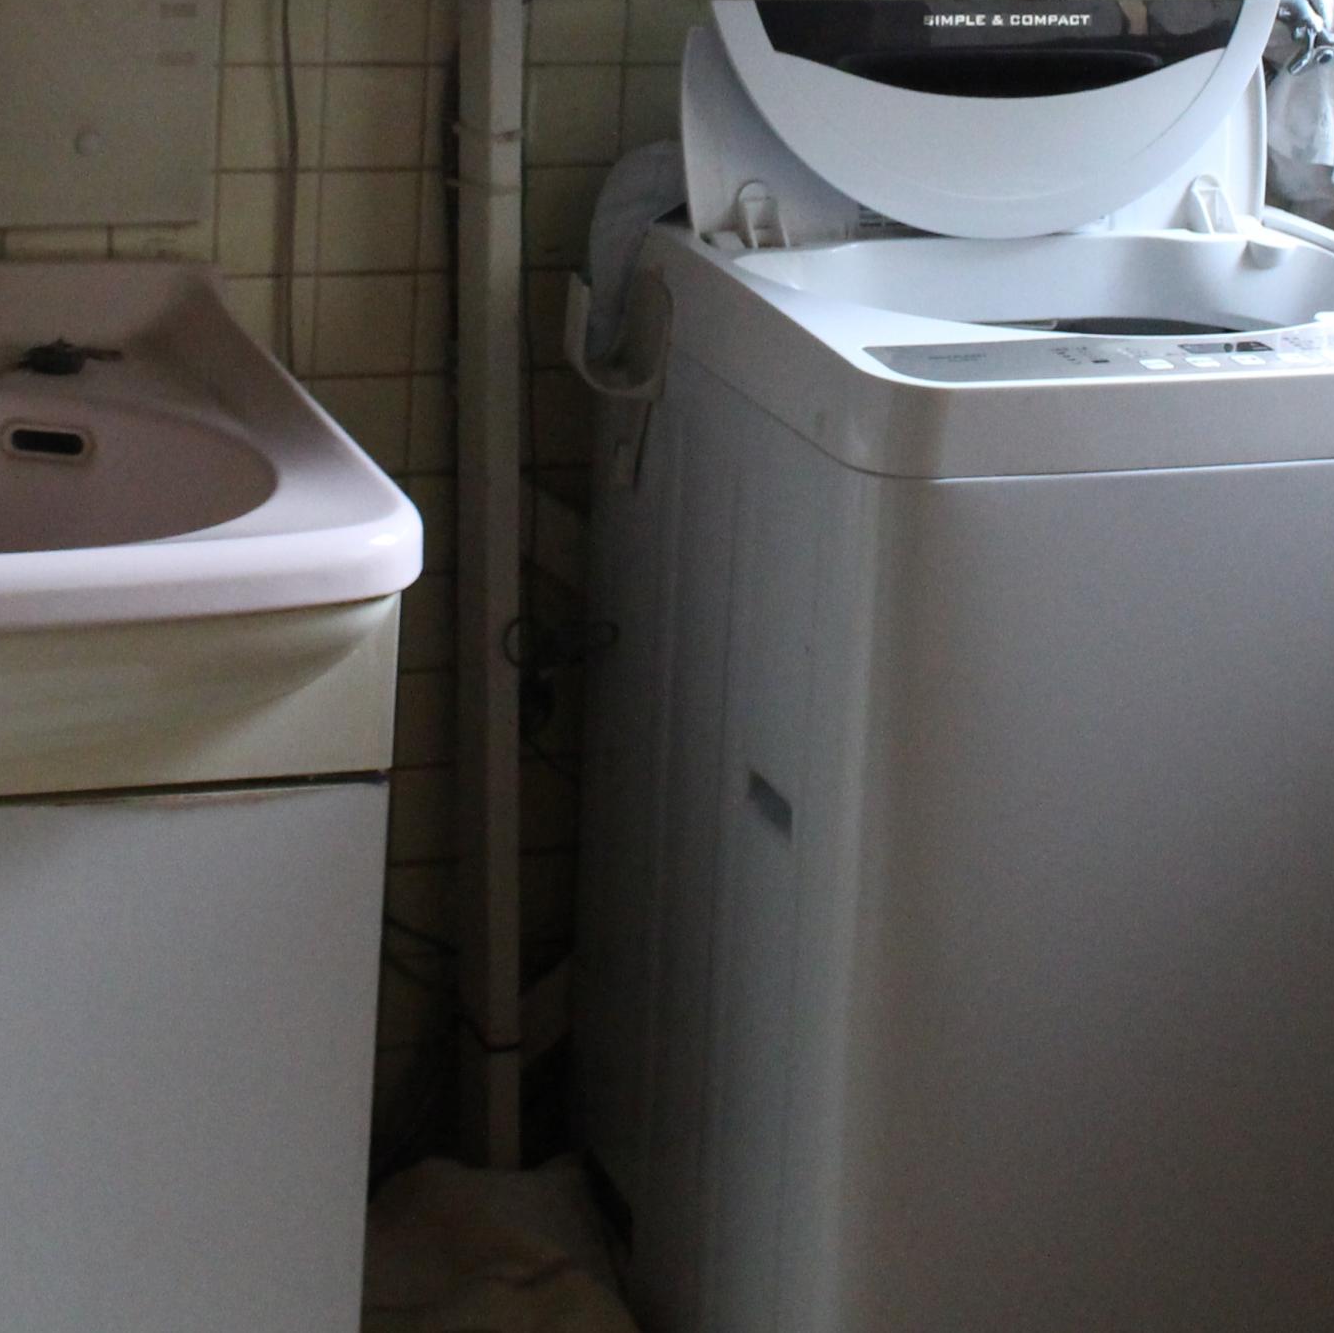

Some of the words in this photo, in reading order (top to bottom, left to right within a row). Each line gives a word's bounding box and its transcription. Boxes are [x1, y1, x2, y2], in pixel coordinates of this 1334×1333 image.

[923, 14, 986, 26] SIMPLE
[991, 14, 1003, 26] &
[1010, 14, 1090, 25] COMPACT
